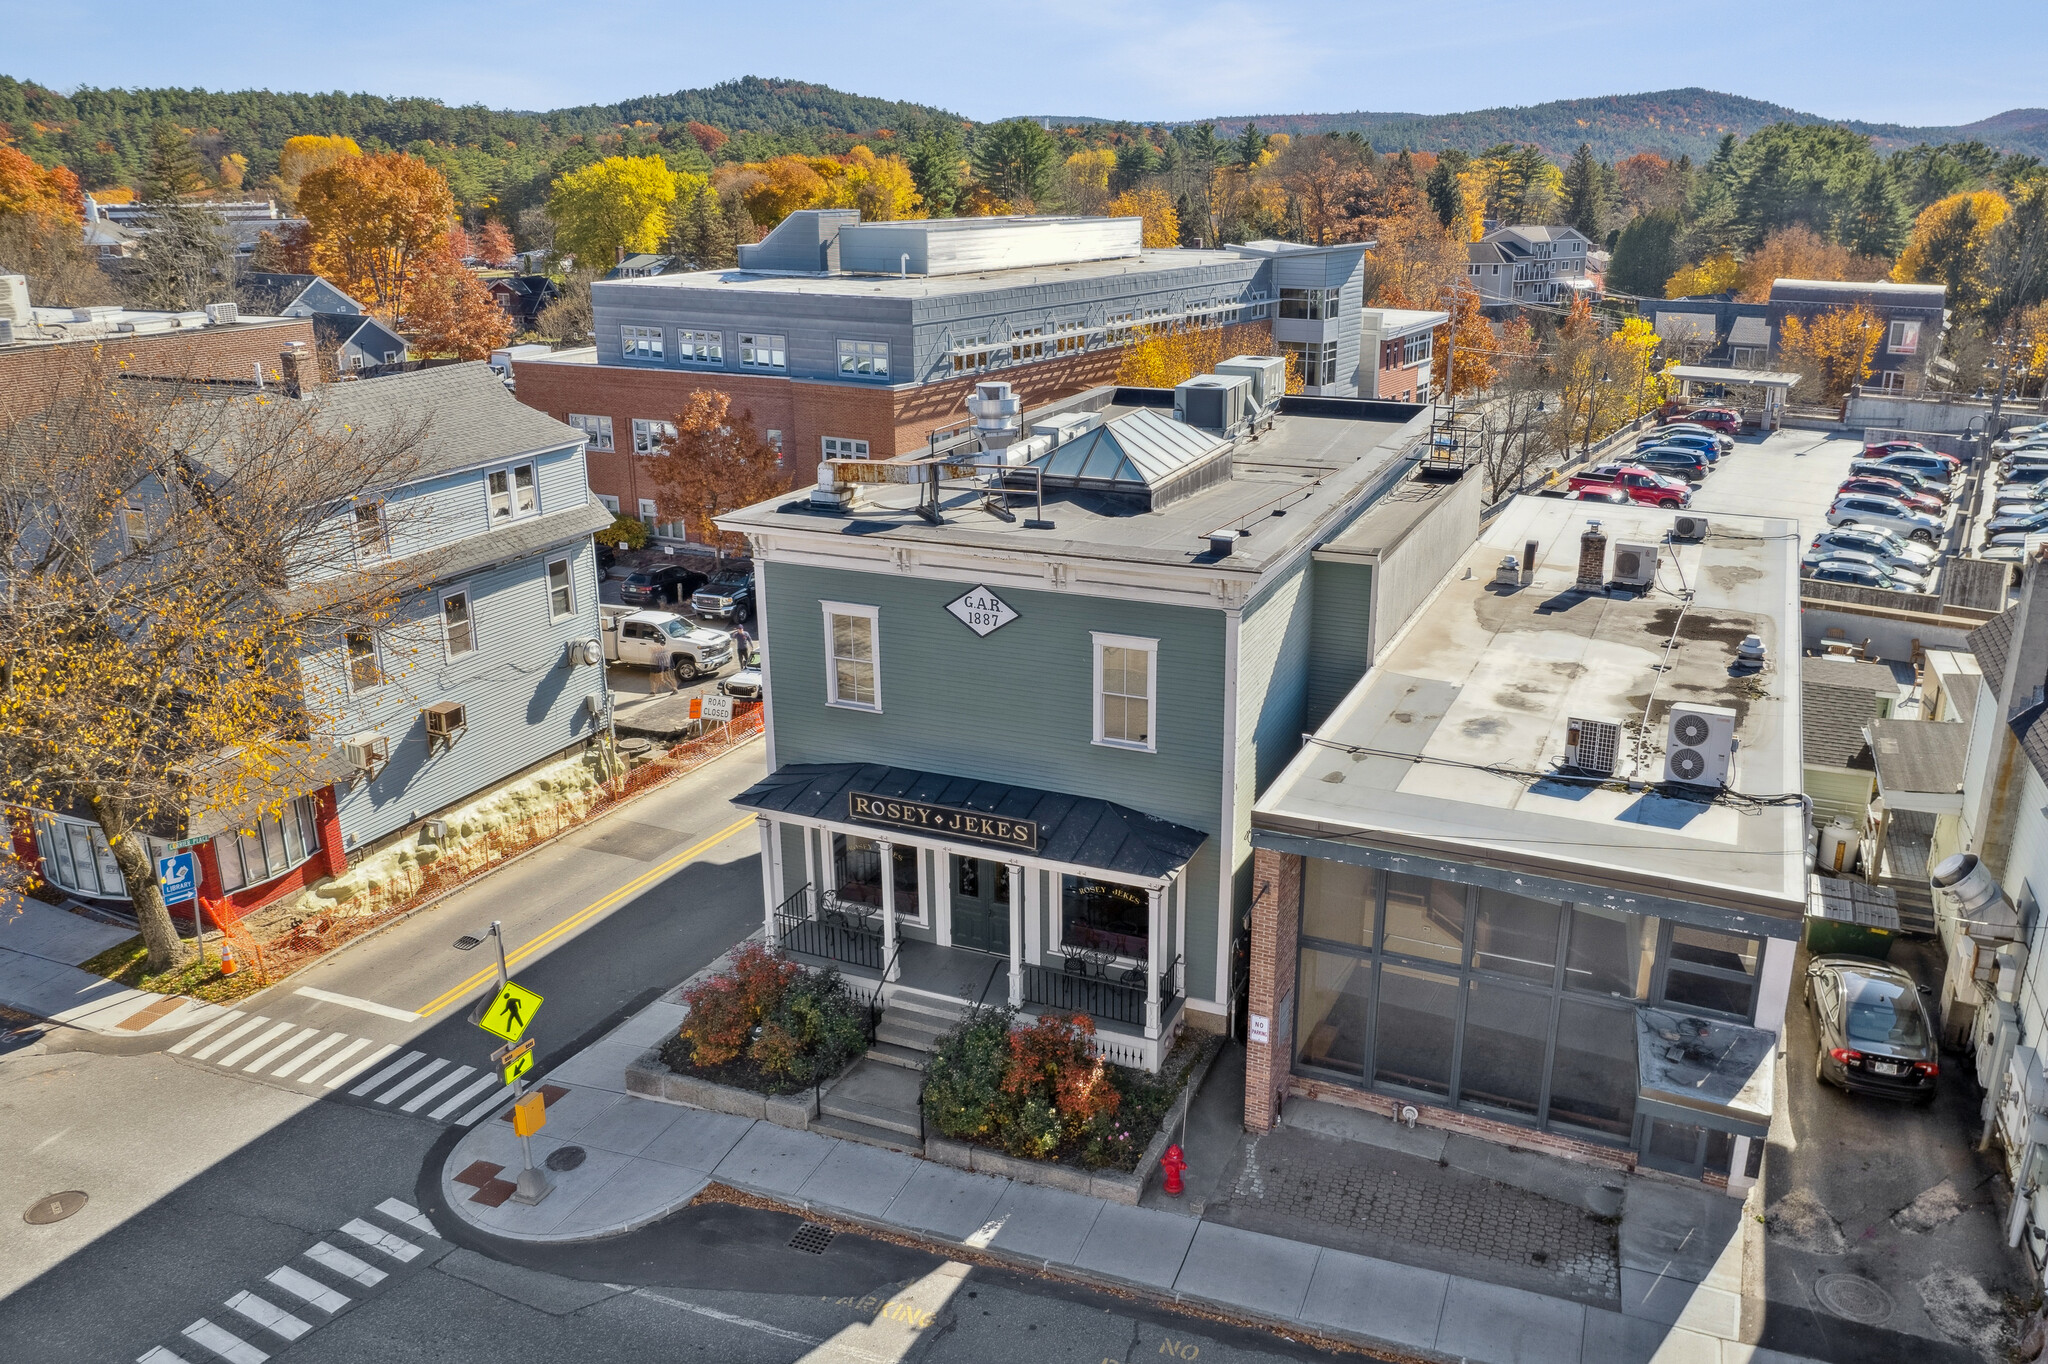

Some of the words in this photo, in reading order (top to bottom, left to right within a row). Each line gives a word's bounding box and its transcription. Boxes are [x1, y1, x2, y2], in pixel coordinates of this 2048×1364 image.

[964, 596, 1003, 612] G.A.R.
[968, 612, 998, 626] 1887
[708, 698, 726, 707] ROAD
[704, 708, 728, 718] CLOSED
[856, 797, 931, 824] ROSEY
[949, 814, 1028, 841] JEKES
[192, 835, 209, 845] PLACE
[166, 881, 192, 892] LIBRARY
[1078, 886, 1106, 894] ROSEY
[1112, 889, 1140, 904] JEKES
[1158, 1338, 1200, 1361] NO
